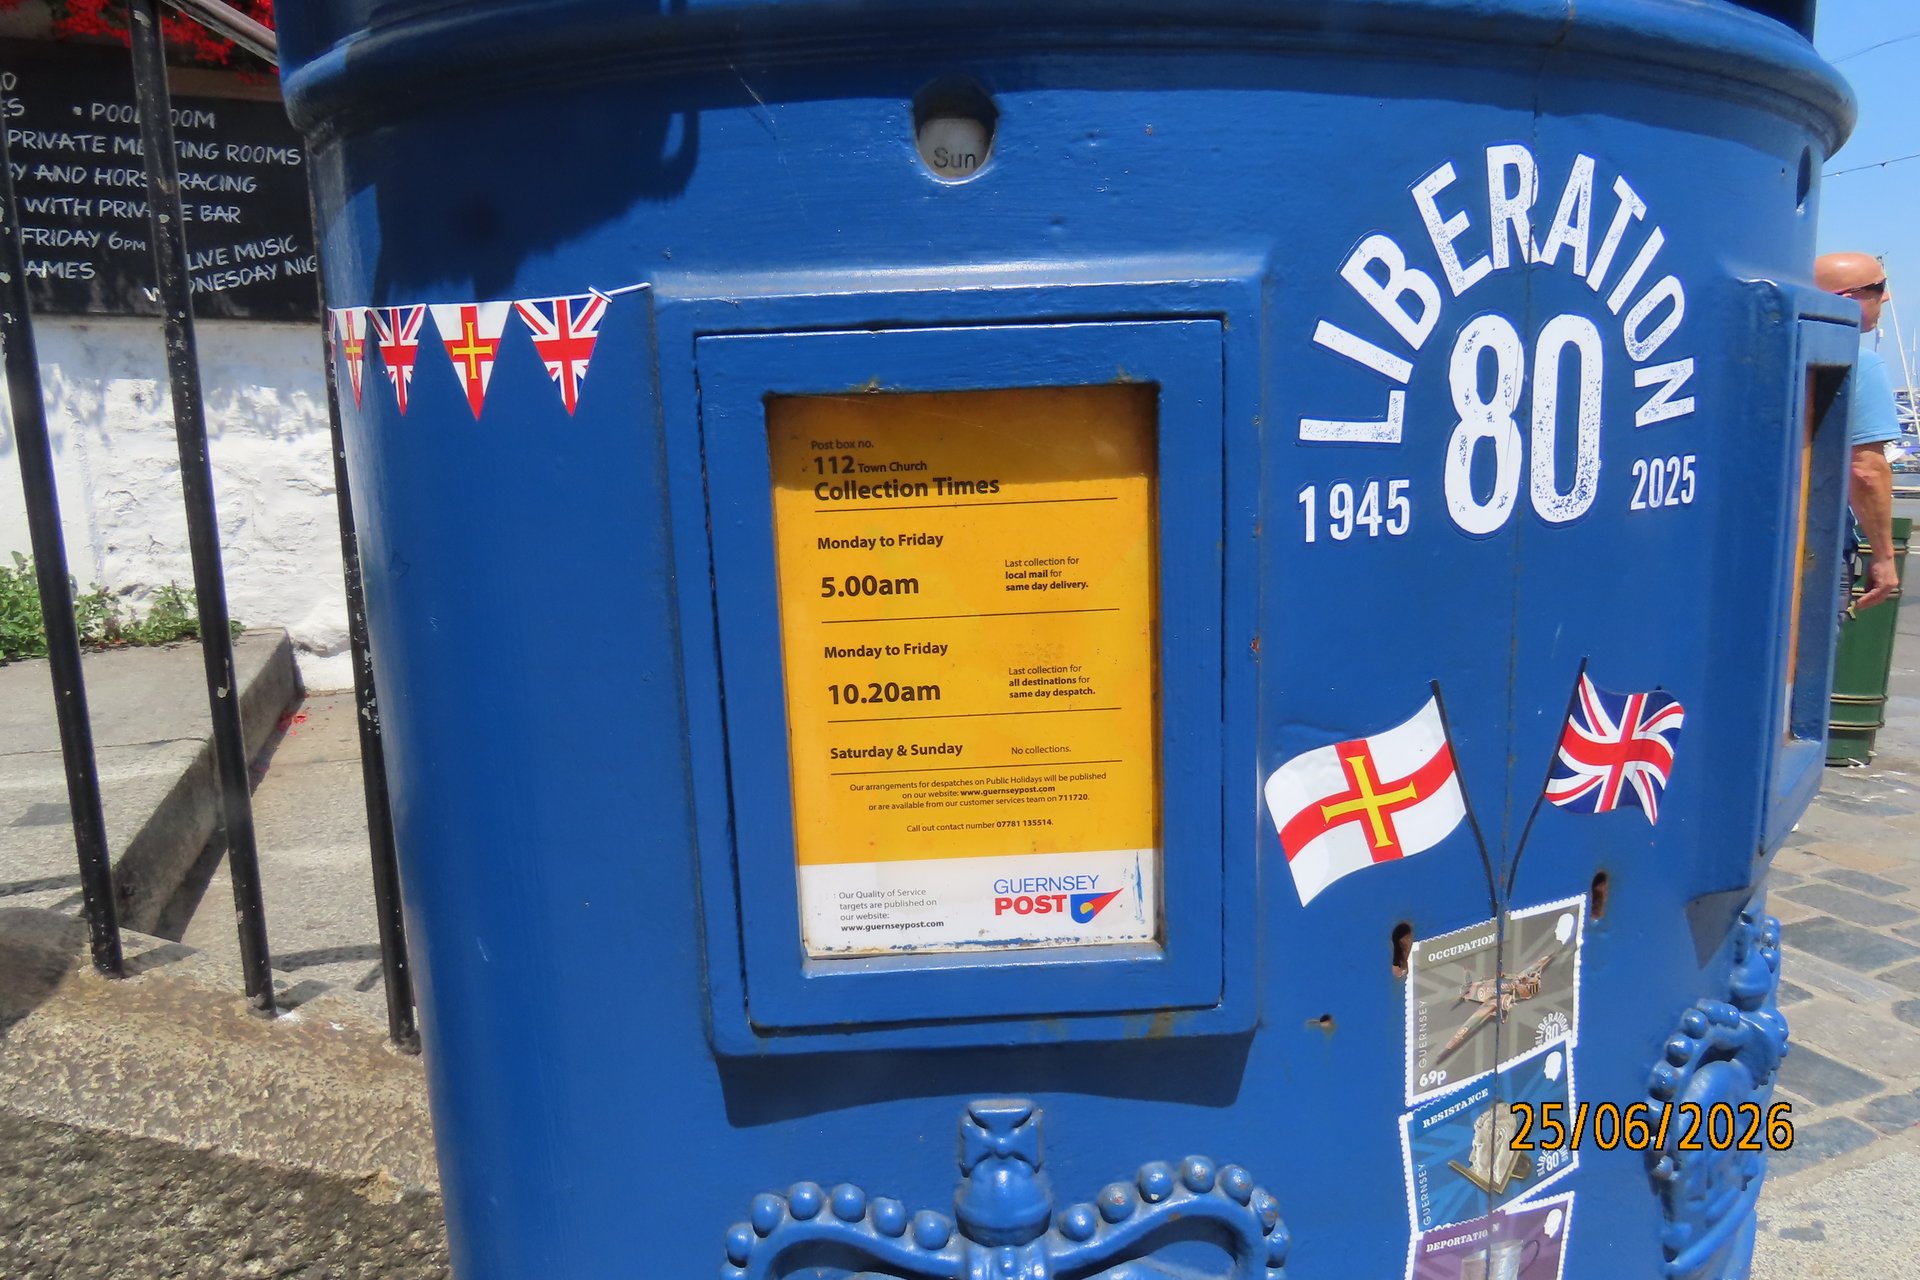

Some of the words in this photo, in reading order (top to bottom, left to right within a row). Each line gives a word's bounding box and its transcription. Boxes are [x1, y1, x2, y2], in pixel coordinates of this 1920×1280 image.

[168, 108, 215, 129] OOM
[8, 129, 106, 153] PRIVATE
[113, 136, 220, 160] MEING
[226, 144, 301, 166] ROOMS
[933, 146, 976, 169] Sun
[33, 164, 87, 184] AND
[94, 166, 148, 189] HORS
[178, 172, 258, 193] RACING
[23, 197, 91, 217] WITH
[98, 199, 194, 222] PRIVE
[200, 206, 241, 224] BAR
[21, 227, 101, 248] FRIDAY
[186, 247, 230, 272] LIVE
[234, 235, 298, 262] MUSIC
[24, 260, 96, 280] AMES
[284, 255, 317, 276] NIG
[1299, 144, 1695, 444] LIBERATION
[1444, 314, 1603, 534] 80
[811, 440, 833, 450] Post
[836, 440, 855, 449] box
[858, 440, 874, 449] no.
[814, 456, 855, 475] 112
[858, 462, 886, 473] Town
[889, 461, 927, 472] Church
[815, 479, 928, 500] Collection
[933, 477, 1000, 495] Times
[1630, 455, 1696, 511] 2025
[1298, 479, 1411, 542] 1945
[817, 536, 876, 551] Monday
[880, 535, 894, 547] to
[898, 534, 944, 547] Friday
[1005, 559, 1021, 568] Last
[1024, 557, 1065, 567] collection
[1067, 557, 1079, 565] for
[1005, 571, 1026, 579] local
[1029, 570, 1048, 578] mail
[1050, 569, 1061, 577] for
[821, 576, 919, 598] 5.00am
[1006, 583, 1029, 591] same
[1032, 582, 1047, 592] day
[1050, 580, 1088, 590] delivery.
[824, 645, 882, 659] Monday
[886, 644, 900, 655] to
[904, 643, 948, 656] Friday
[1027, 665, 1067, 674] collection
[1070, 665, 1081, 673] for
[1009, 678, 1019, 686] all
[1022, 677, 1076, 685] destinations
[1078, 676, 1090, 684] for
[828, 682, 941, 704] 10.20am
[1035, 689, 1050, 698] day
[1053, 687, 1095, 698] despatch.
[830, 746, 893, 760] Saturday
[897, 745, 907, 756] &
[911, 744, 963, 756] Sunday
[1011, 747, 1023, 755] No
[1025, 745, 1071, 754] collections.
[850, 783, 863, 791] Our
[866, 780, 916, 791] arrangements
[931, 778, 972, 788] despatches
[986, 777, 1008, 785] Public
[1011, 775, 1042, 785] Holidays
[1044, 774, 1056, 782] will
[1070, 772, 1106, 782] published
[891, 801, 923, 809] available
[925, 800, 943, 808] from
[959, 798, 993, 806] customer
[996, 796, 1025, 804] services
[1059, 793, 1089, 801] 711720.
[928, 789, 959, 798] website:
[961, 786, 1055, 797] www.guernseypost.com
[937, 823, 966, 831] contact
[968, 821, 994, 830] number
[996, 820, 1020, 828] 07781
[1023, 819, 1053, 827] 135514.
[839, 891, 854, 899] Our
[856, 890, 884, 900] Quality
[898, 888, 926, 896] Service
[994, 874, 1099, 894] GUERNSEY
[840, 902, 866, 911] targets
[868, 901, 882, 909] are
[884, 899, 924, 909] published
[994, 894, 1067, 915] POST
[841, 919, 944, 933] www.guernseypost.com
[857, 912, 889, 920] website:
[1428, 933, 1496, 962] OCCUPATION
[1418, 1000, 1428, 1069] GUERNSEY
[1545, 1023, 1559, 1041] 80
[1419, 1070, 1447, 1087] 69p
[1422, 1088, 1489, 1128] RESISTANCE
[1418, 1164, 1432, 1225] GUERNSEY
[1426, 1223, 1499, 1252] DEPORTATION
